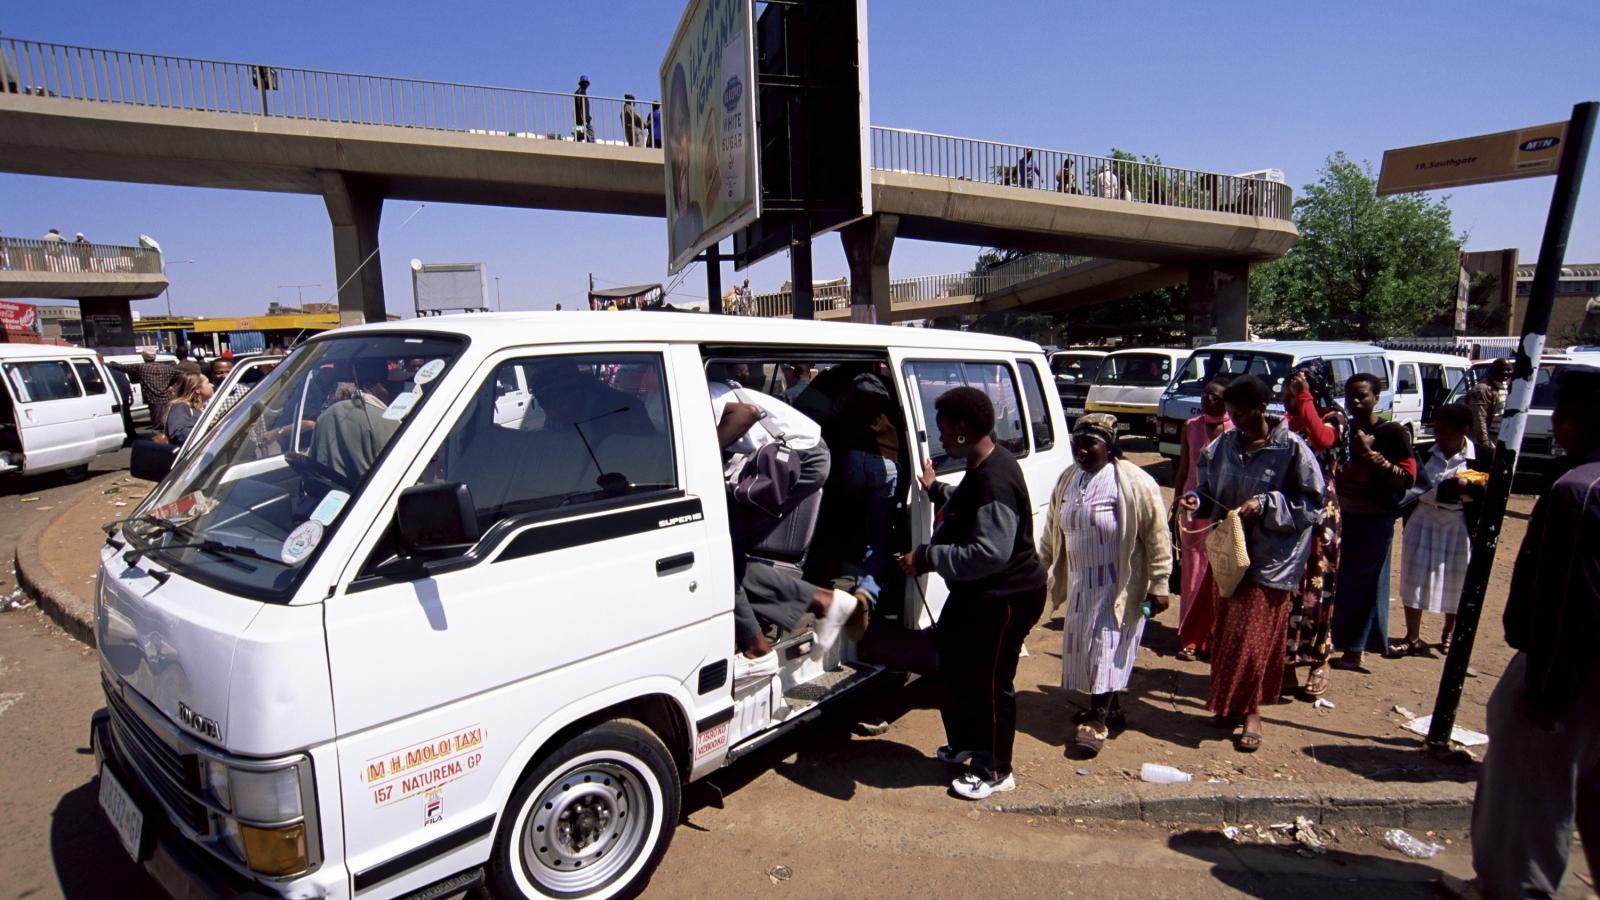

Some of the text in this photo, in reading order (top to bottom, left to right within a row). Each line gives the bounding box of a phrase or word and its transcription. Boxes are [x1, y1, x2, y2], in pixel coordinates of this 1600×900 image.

[724, 112, 742, 132] WHITE
[722, 132, 742, 152] SUGAR
[1525, 138, 1553, 150] MTN
[178, 700, 222, 741] TOYOTA
[406, 738, 451, 768] MOLOI
[454, 727, 482, 751] TAXI
[374, 753, 482, 804] 157 NATURENA GP
[424, 816, 443, 827] FILA
